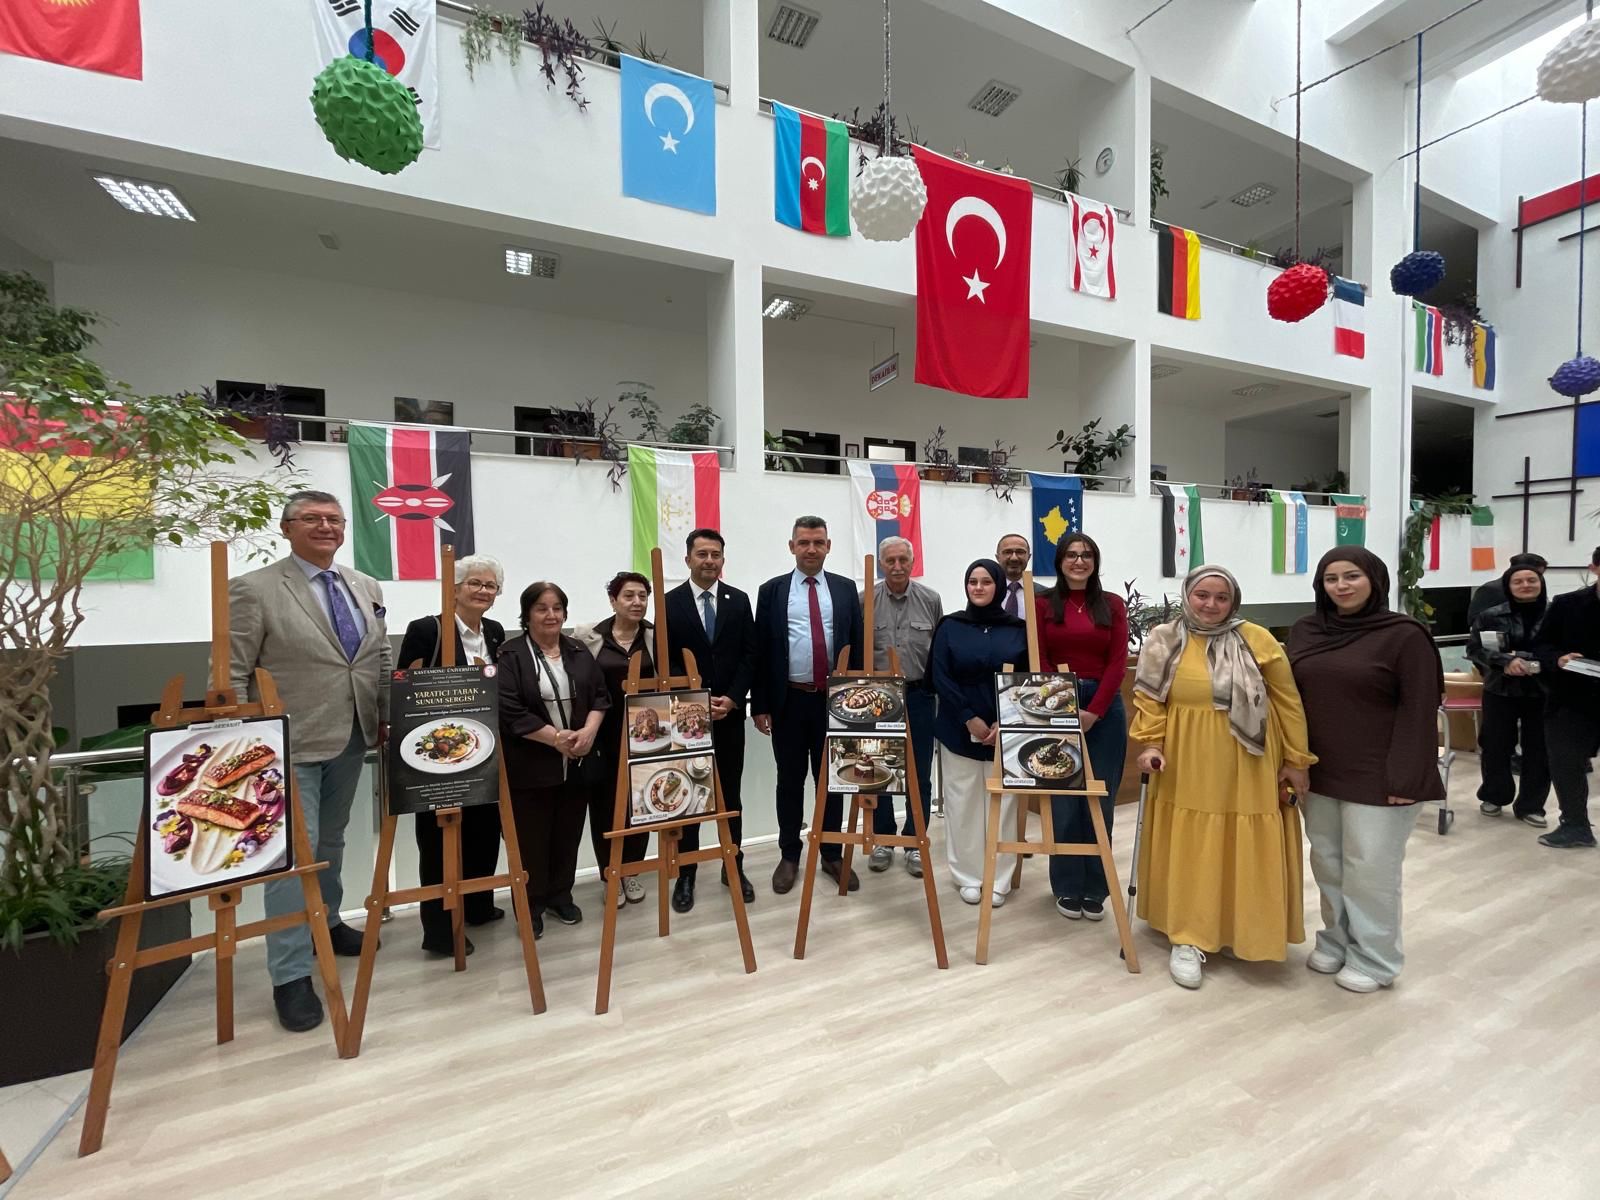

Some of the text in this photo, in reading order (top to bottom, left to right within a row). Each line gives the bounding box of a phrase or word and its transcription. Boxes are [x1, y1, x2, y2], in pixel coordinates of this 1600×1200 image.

[414, 687, 479, 699] YARATICI TABAK
[415, 695, 475, 706] SUNUM SERGİSİ
